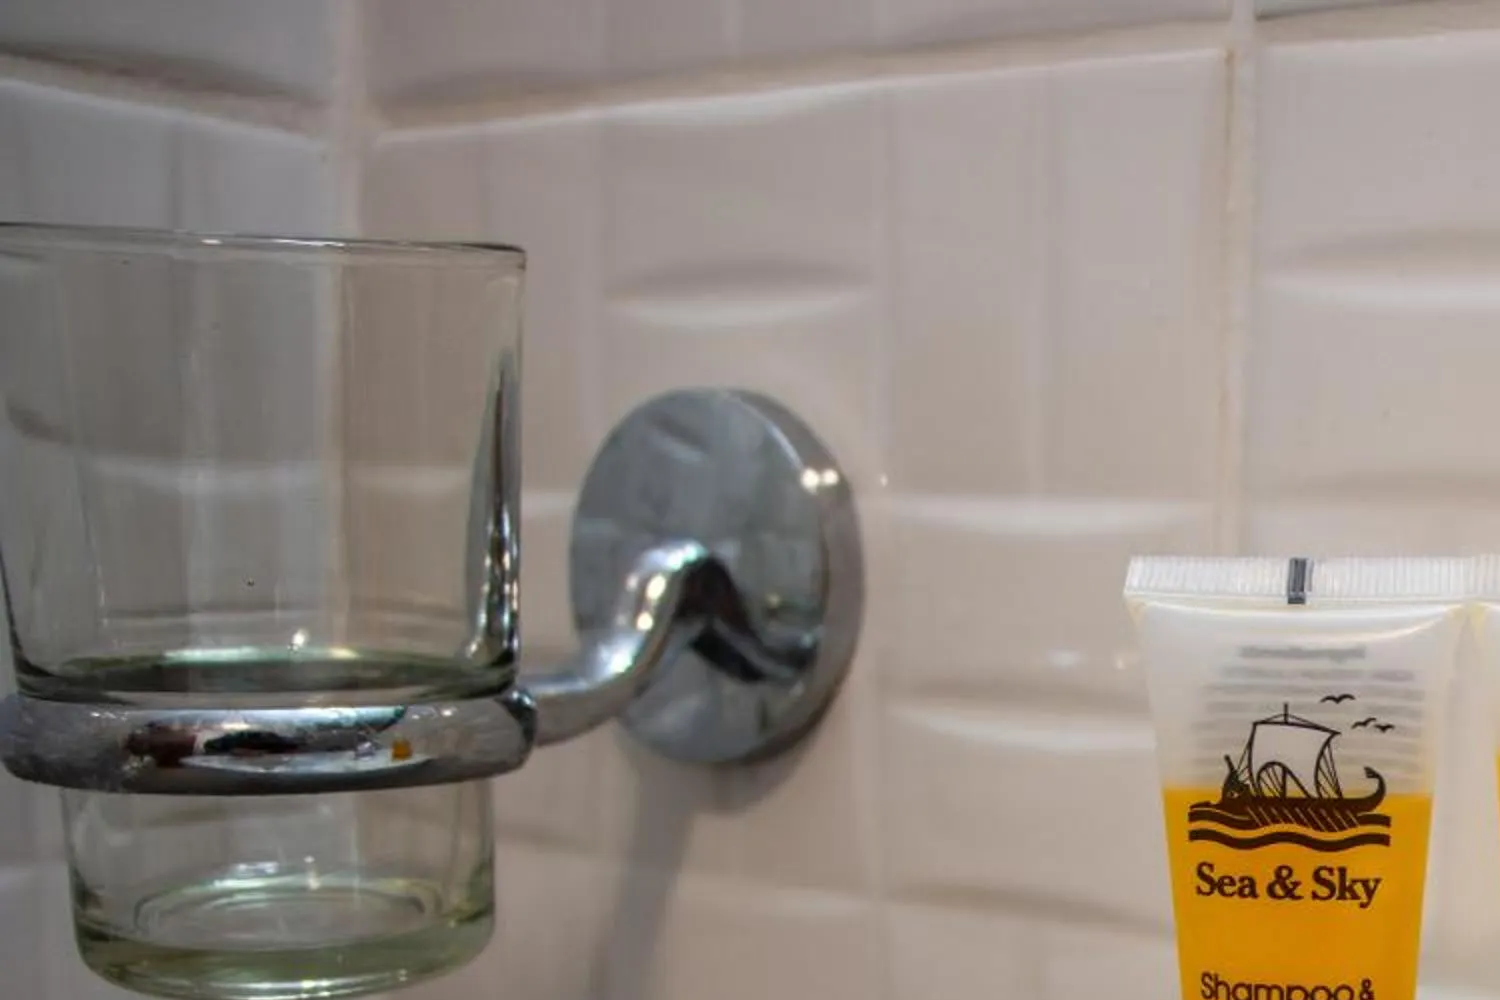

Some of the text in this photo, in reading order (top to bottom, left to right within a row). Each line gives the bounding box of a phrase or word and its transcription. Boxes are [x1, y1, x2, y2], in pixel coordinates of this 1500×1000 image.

[1196, 862, 1382, 908] Sea & Sky
